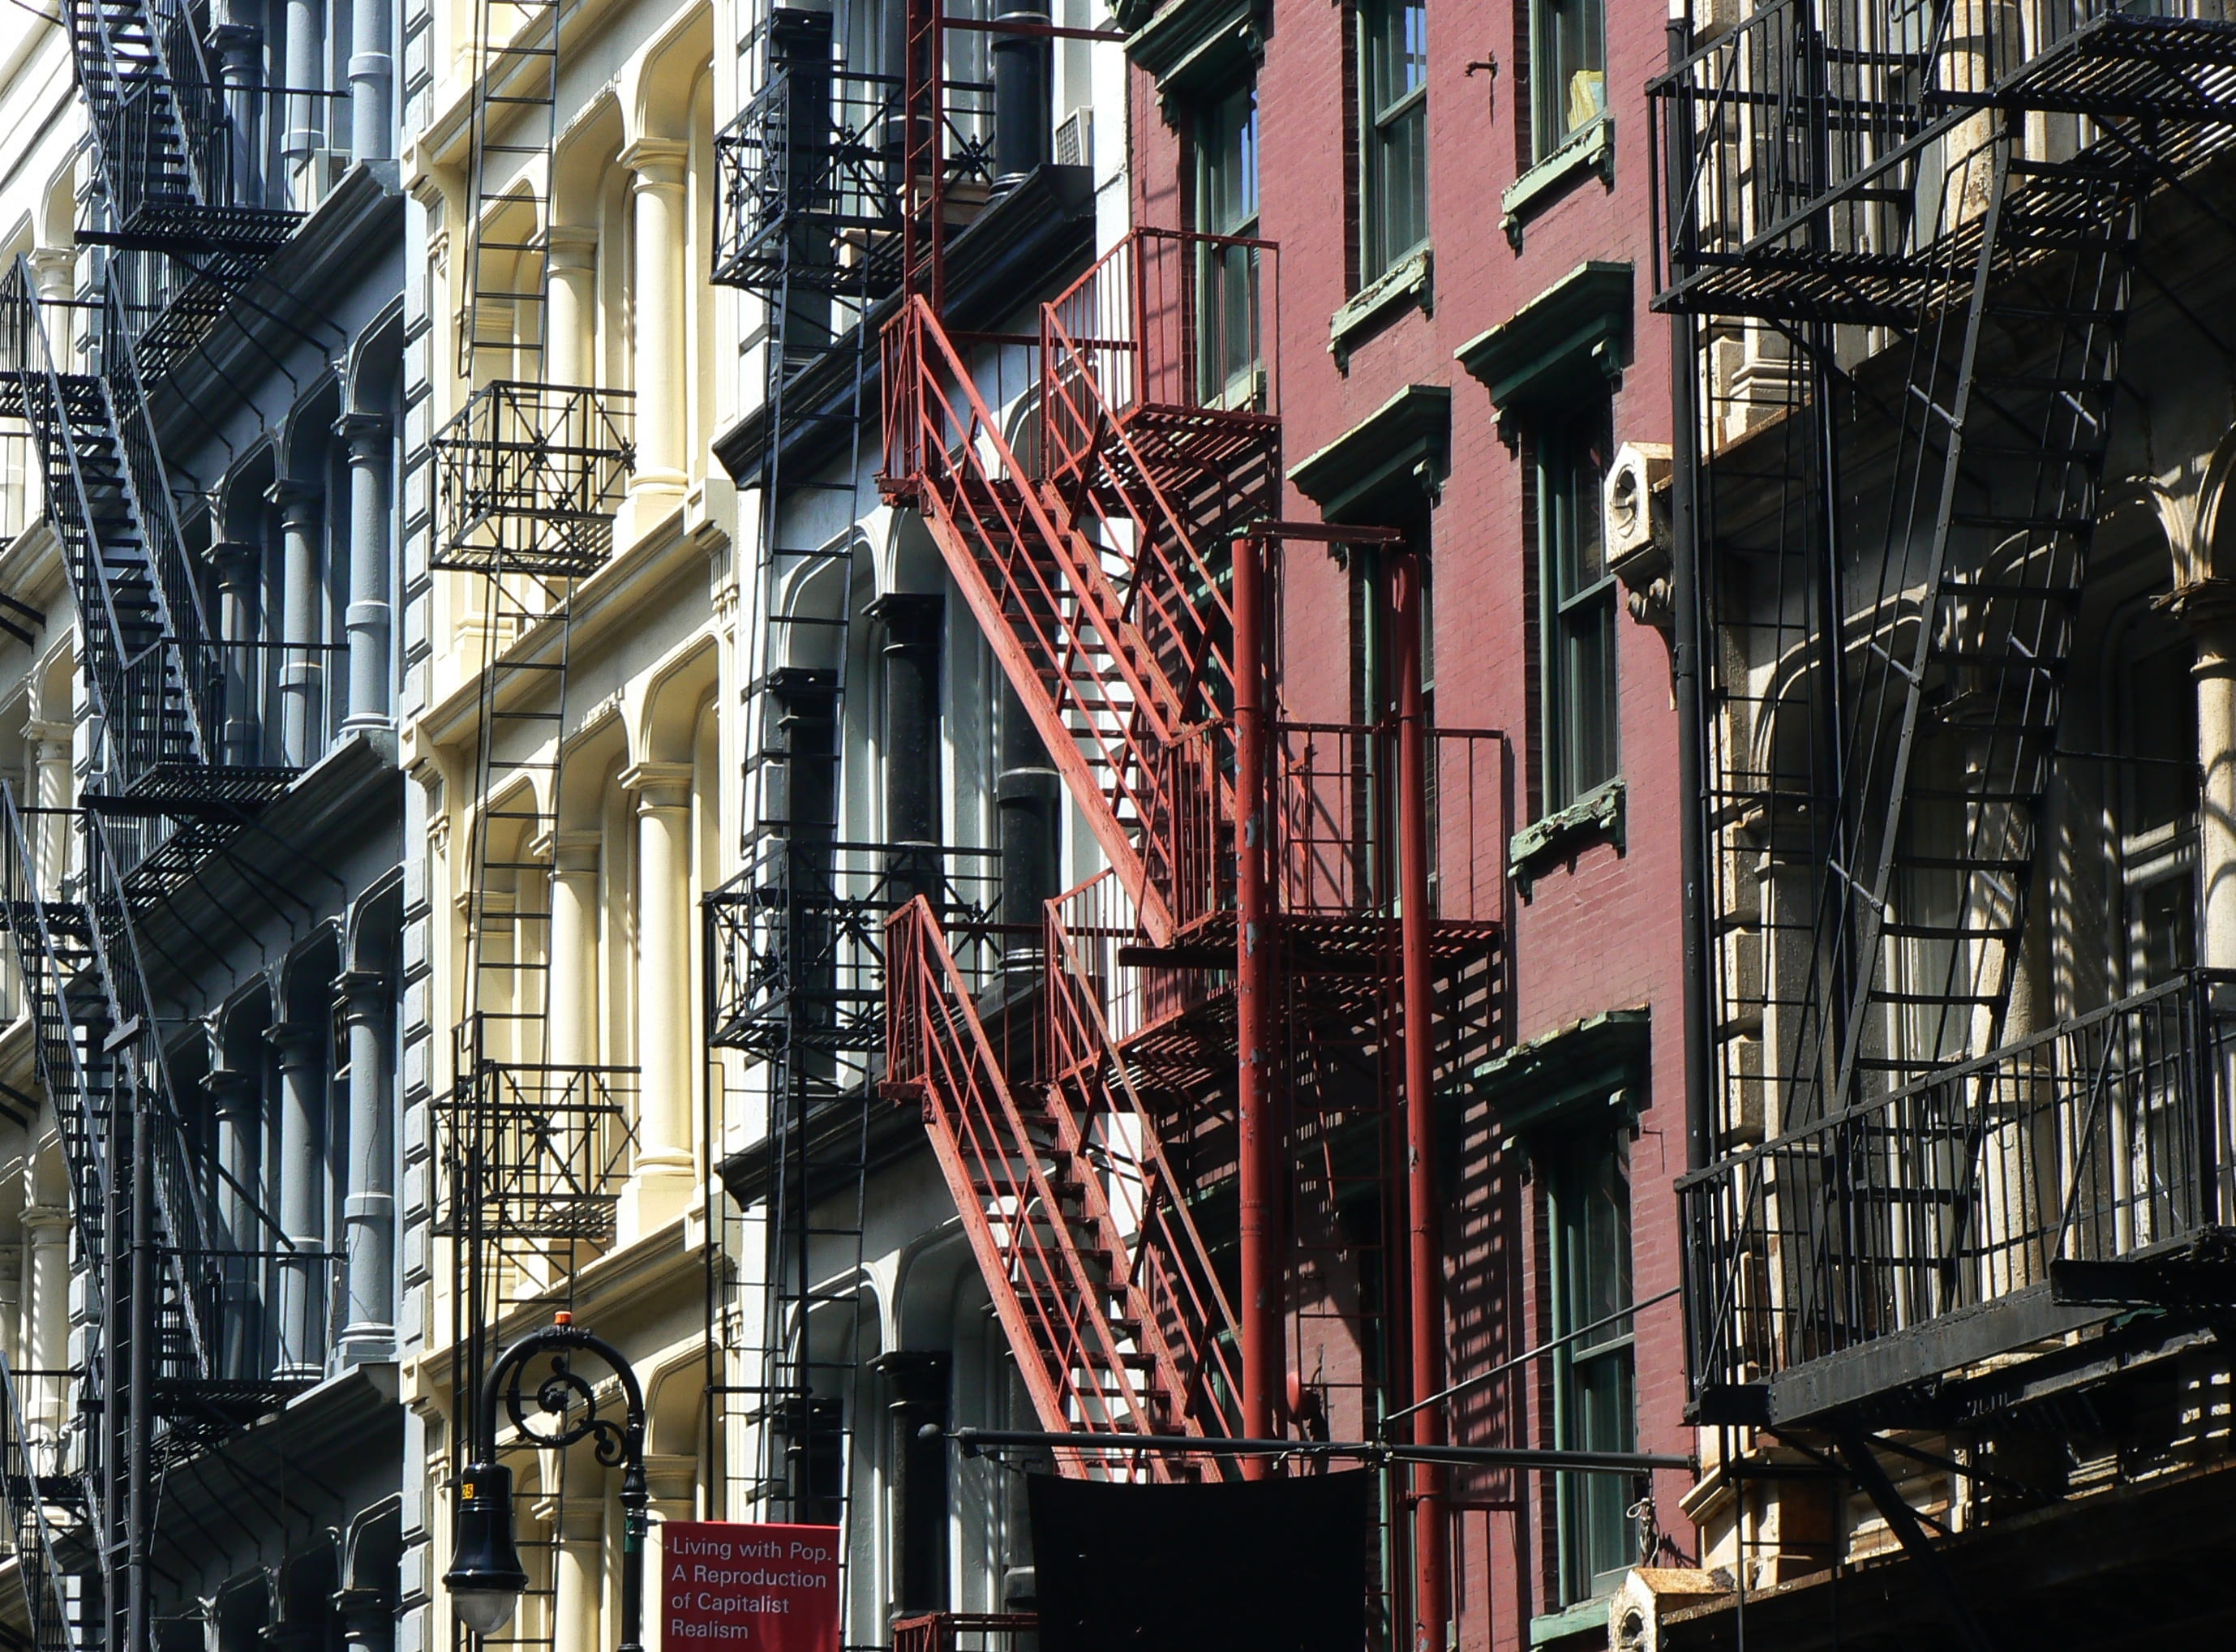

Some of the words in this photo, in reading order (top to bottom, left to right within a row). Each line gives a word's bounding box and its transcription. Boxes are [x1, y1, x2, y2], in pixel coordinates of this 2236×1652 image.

[673, 1537, 732, 1560] Living
[739, 1541, 782, 1559] with
[790, 1542, 831, 1564] Pop.
[672, 1564, 686, 1581] A
[694, 1565, 826, 1588] Reproduction
[672, 1592, 691, 1609] of
[697, 1593, 789, 1615] Capitalist
[672, 1619, 749, 1639] Realism
